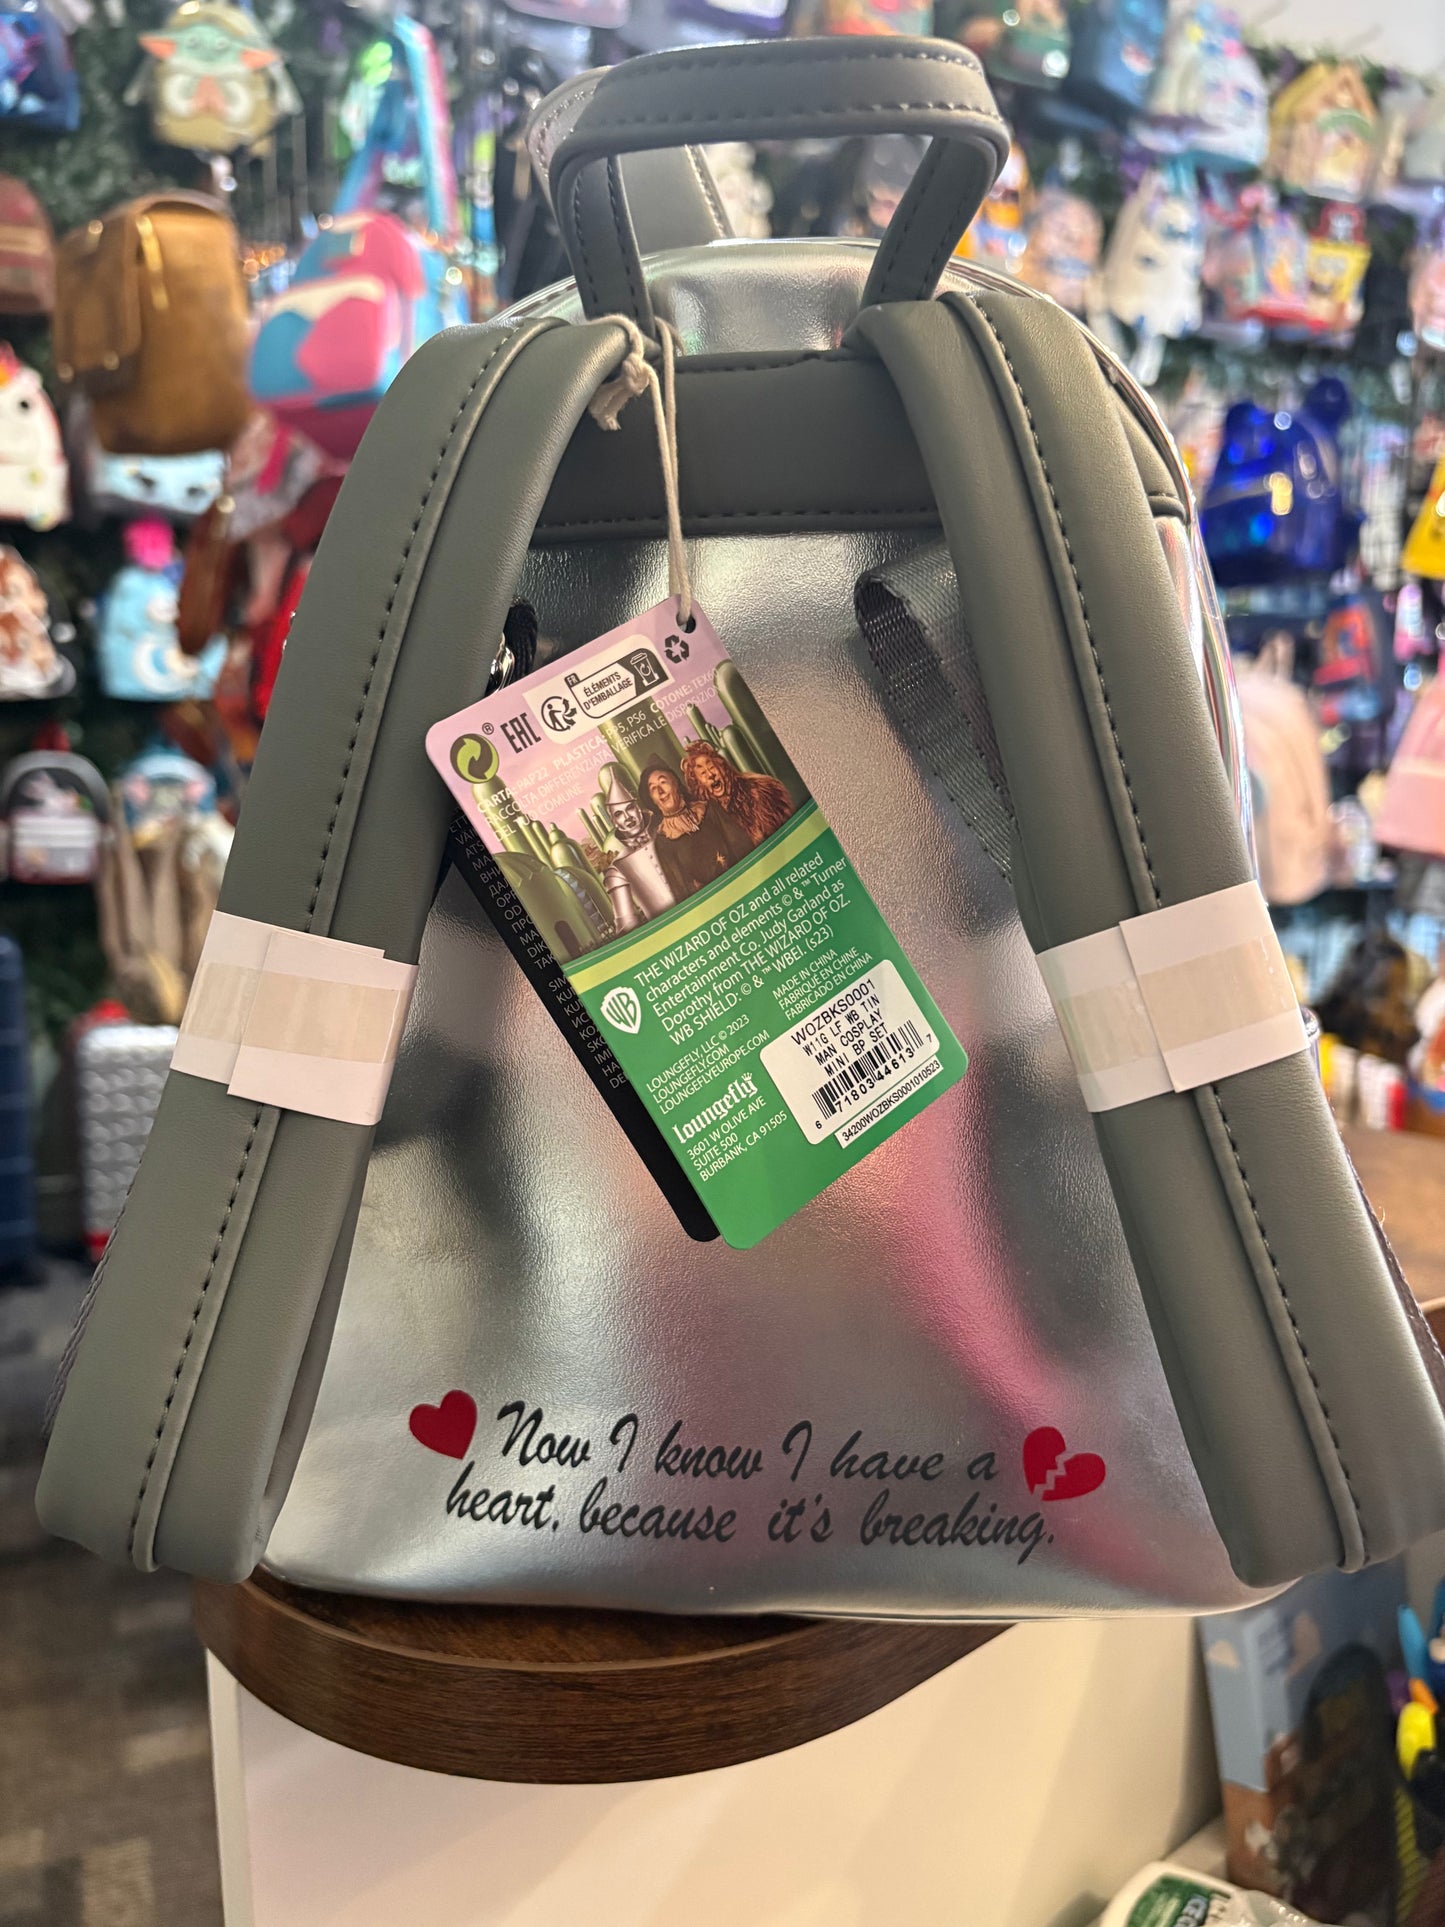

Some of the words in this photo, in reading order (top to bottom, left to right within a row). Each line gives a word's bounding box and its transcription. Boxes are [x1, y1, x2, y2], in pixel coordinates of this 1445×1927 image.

[566, 674, 578, 686] FR
[582, 668, 621, 697] ÉLÉMENTS
[583, 677, 633, 710] D'EMBALLAGE
[476, 784, 518, 814] CARTA:
[516, 766, 549, 791] PAP22
[552, 732, 607, 771] PLASTICA:
[626, 709, 647, 727] PS6
[649, 682, 693, 714] COTONE:
[500, 711, 541, 754] EAC
[485, 790, 539, 828] RACCOLTA
[611, 722, 655, 754] VERIFICA
[653, 715, 667, 730] LE
[494, 822, 516, 841] DEL
[514, 809, 539, 830] TUO
[537, 782, 583, 816] COMUNE
[634, 962, 663, 988] THE
[659, 929, 712, 971] WIZARD
[709, 916, 730, 937] OF
[727, 903, 750, 925] OZ
[746, 888, 772, 912] and
[768, 878, 786, 896] all
[783, 852, 824, 886] related
[643, 952, 708, 1003] characters
[704, 936, 732, 961] and
[728, 900, 784, 944] elements
[790, 885, 804, 900] &
[810, 856, 849, 887] Turner
[652, 949, 741, 1017] Entertainment
[737, 936, 761, 958] Co.
[757, 916, 791, 946] Judy
[785, 886, 832, 924] Garland
[830, 878, 845, 894] as
[661, 989, 717, 1033] Dorothy
[711, 968, 744, 997] from
[740, 951, 768, 976] THE
[764, 919, 814, 959] WIZARD
[811, 907, 831, 926] OF
[827, 892, 851, 914] OZ.
[669, 1022, 695, 1046] WB
[692, 989, 743, 1031] SHIELD:
[750, 973, 765, 989] &
[771, 943, 807, 974] WBEI.
[804, 924, 836, 952] (s23)
[772, 975, 801, 1000] MADE
[798, 968, 811, 981] IN
[808, 948, 838, 973] CHINA
[778, 974, 821, 1010] FABRIQUÉ
[819, 966, 833, 981] EN
[831, 947, 860, 972] CHINE
[784, 980, 835, 1021] FABRICADO
[832, 971, 847, 986] EN
[844, 952, 873, 977] CHINA
[791, 978, 876, 1046] WOZBKS0001
[802, 1033, 829, 1057] W11G
[829, 1020, 845, 1037] LF
[845, 1009, 861, 1025] WB
[860, 994, 880, 1013] TIN
[815, 1044, 838, 1066] MAN
[839, 1008, 885, 1048] COSPLAY
[646, 1048, 704, 1093] LOUNGEFLY,
[701, 1036, 720, 1054] LLC
[726, 1014, 750, 1035] 2023
[652, 1043, 730, 1104] LOUNGEFLY.COM
[659, 1029, 770, 1114] LOUNGEFLYEUROPE.COM
[824, 1053, 850, 1077] MINI
[852, 1040, 868, 1056] BP
[868, 1023, 890, 1043] SET
[671, 1073, 758, 1145] loungefly
[686, 1138, 711, 1160] 3601
[709, 1129, 723, 1143] W
[720, 1110, 749, 1135] OLIVE
[746, 1096, 767, 1115] AVE
[693, 1146, 722, 1171] SUITE
[719, 1132, 739, 1151] 500
[699, 1142, 748, 1182] BURBANK,
[745, 1131, 761, 1147] CA
[758, 1110, 788, 1136] 91505
[497, 1400, 590, 1467] Now
[610, 1413, 638, 1473] I
[656, 1420, 762, 1480] know
[782, 1420, 812, 1481] I
[830, 1430, 943, 1481] have
[967, 1451, 998, 1481] a
[580, 1477, 736, 1543] because
[768, 1493, 833, 1543] it's
[861, 1489, 1054, 1566] breaking.
